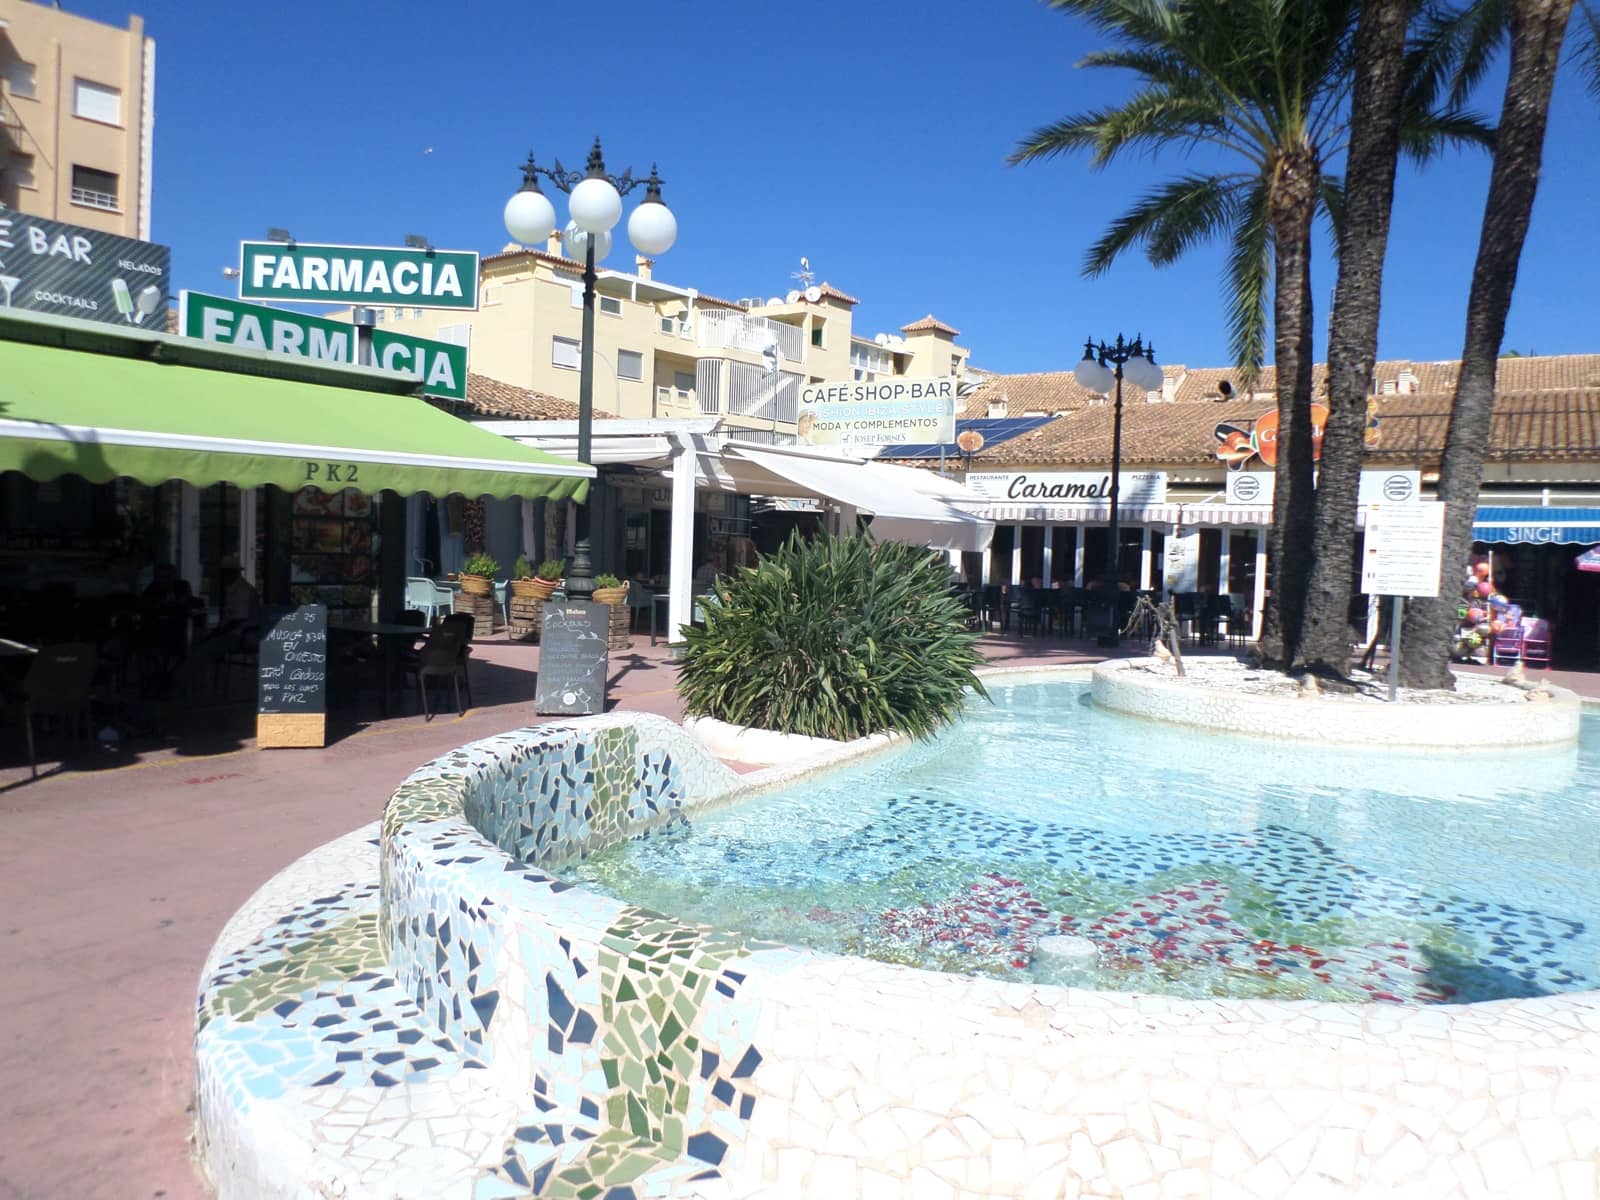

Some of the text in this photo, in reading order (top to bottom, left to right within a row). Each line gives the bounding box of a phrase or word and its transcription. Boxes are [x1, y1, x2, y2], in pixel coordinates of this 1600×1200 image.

[29, 226, 93, 265] BAR
[118, 259, 163, 276] HELADOS
[252, 254, 464, 297] FARMACIA
[34, 289, 98, 311] COCKTAILS
[203, 306, 457, 390] FARMCIA
[812, 418, 939, 431] MODA Y COMPLEMENTOS
[1507, 526, 1563, 541] SINGH
